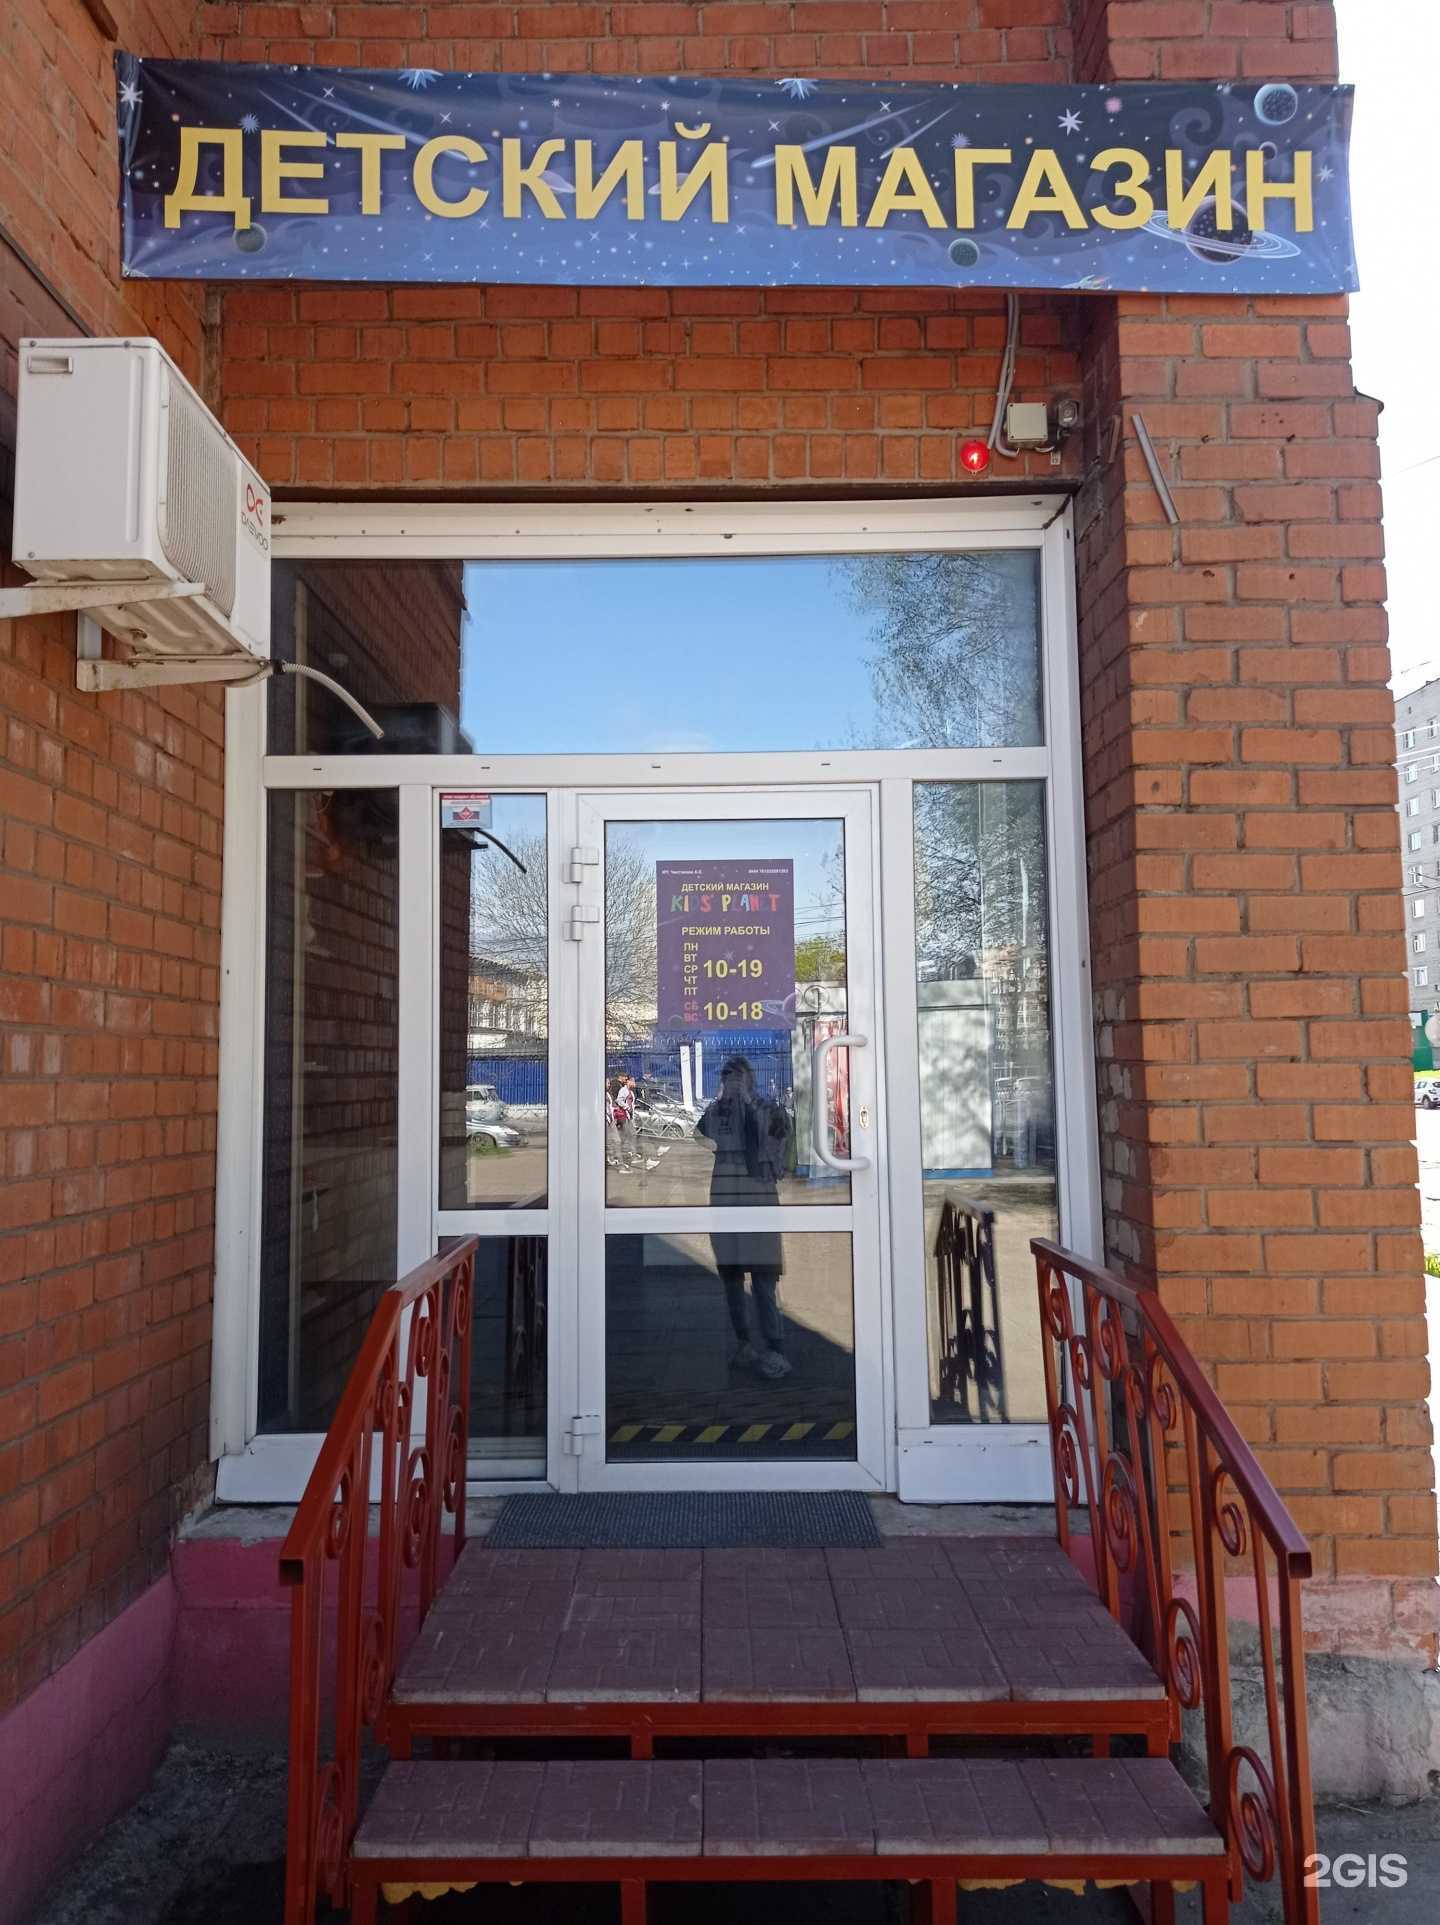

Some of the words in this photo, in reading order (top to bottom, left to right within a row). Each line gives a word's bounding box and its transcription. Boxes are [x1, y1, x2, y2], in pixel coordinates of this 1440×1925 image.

[164, 122, 730, 230] ДЕТСКИЙ
[774, 144, 1315, 232] МАГАЗИН
[681, 883, 725, 892] ДЕТСКИЙ
[726, 882, 769, 891] МАГАЗИН
[681, 926, 722, 936] РЕЖИМ
[724, 925, 770, 935] РАБОТЫ
[684, 942, 698, 951] ПН
[684, 953, 697, 962] ВТ
[684, 964, 698, 974] СР
[703, 959, 763, 978] 10-19
[684, 975, 697, 985] ЧТ
[684, 987, 698, 996] ПТ
[703, 1002, 763, 1021] 10-18
